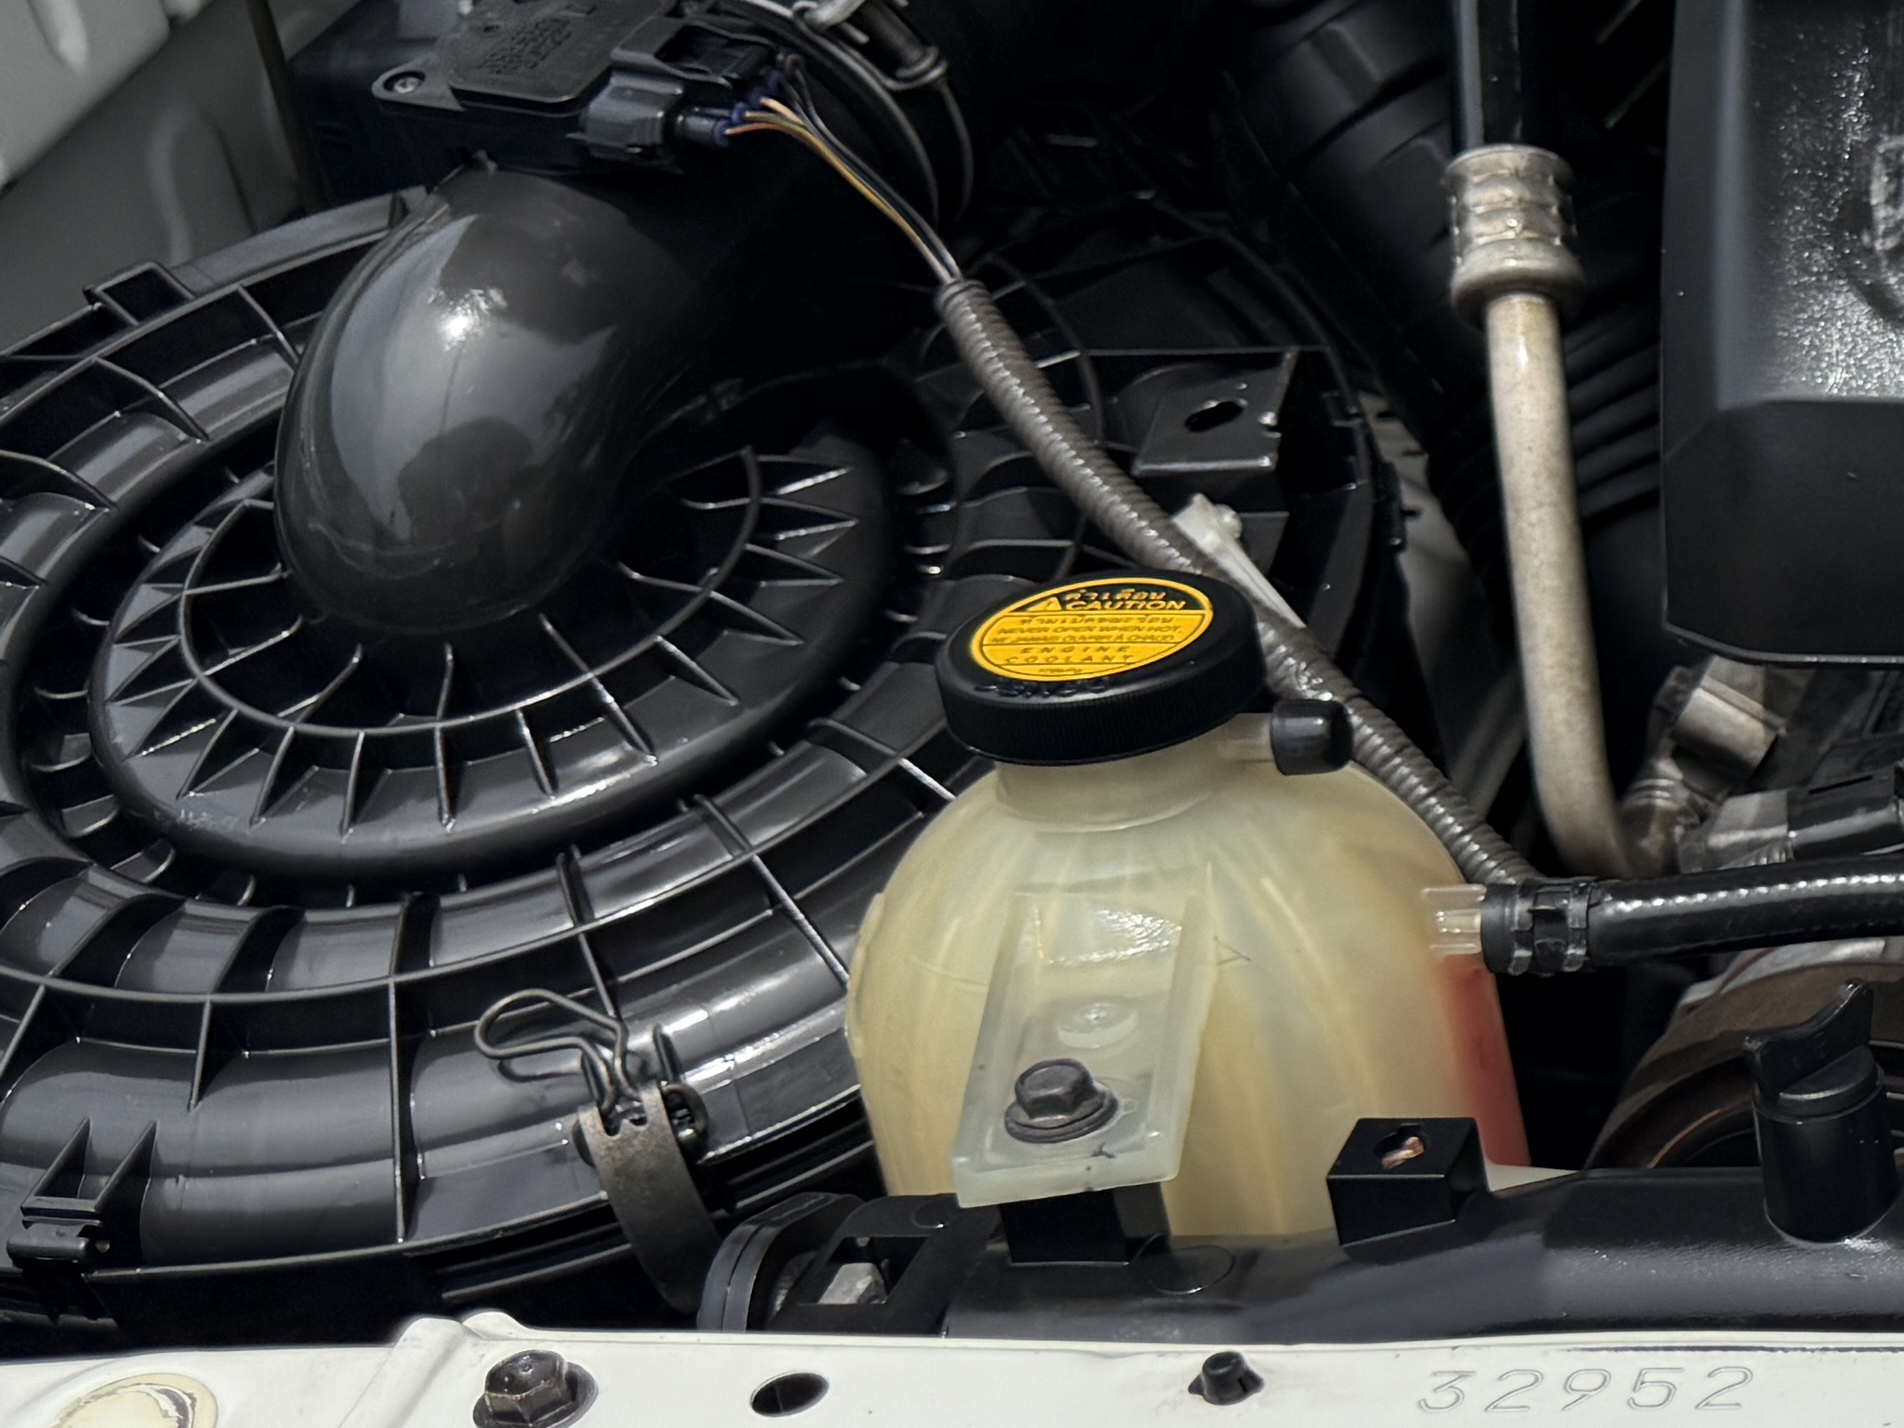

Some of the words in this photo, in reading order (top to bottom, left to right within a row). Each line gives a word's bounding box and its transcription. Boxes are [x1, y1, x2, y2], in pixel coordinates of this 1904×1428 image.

[1065, 600, 1186, 610] CAUTION
[1020, 645, 1132, 655] ENGINE
[1005, 655, 1135, 664] COOLANT
[1417, 1365, 1755, 1413] 32952
